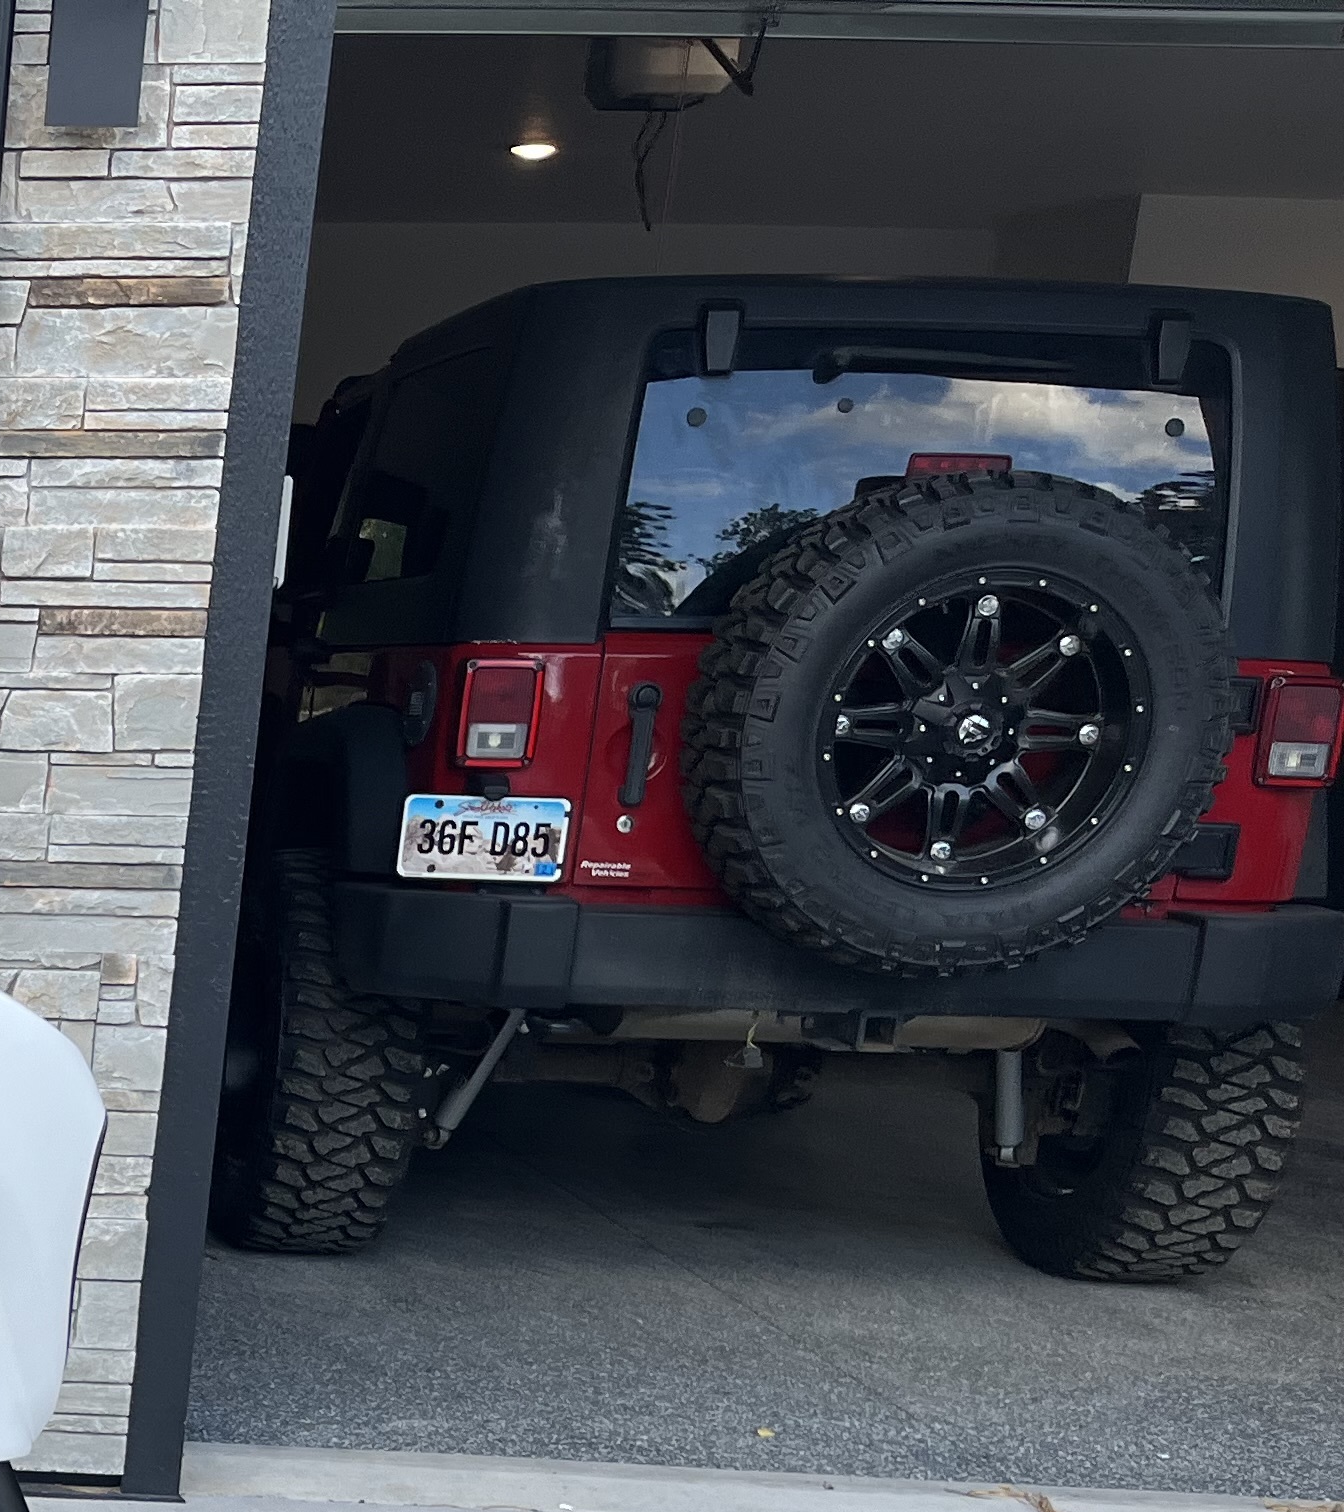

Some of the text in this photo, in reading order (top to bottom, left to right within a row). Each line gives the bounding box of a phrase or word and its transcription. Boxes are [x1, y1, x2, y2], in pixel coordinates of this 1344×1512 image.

[417, 819, 552, 858] 36F D85
[580, 860, 632, 870] Repairable
